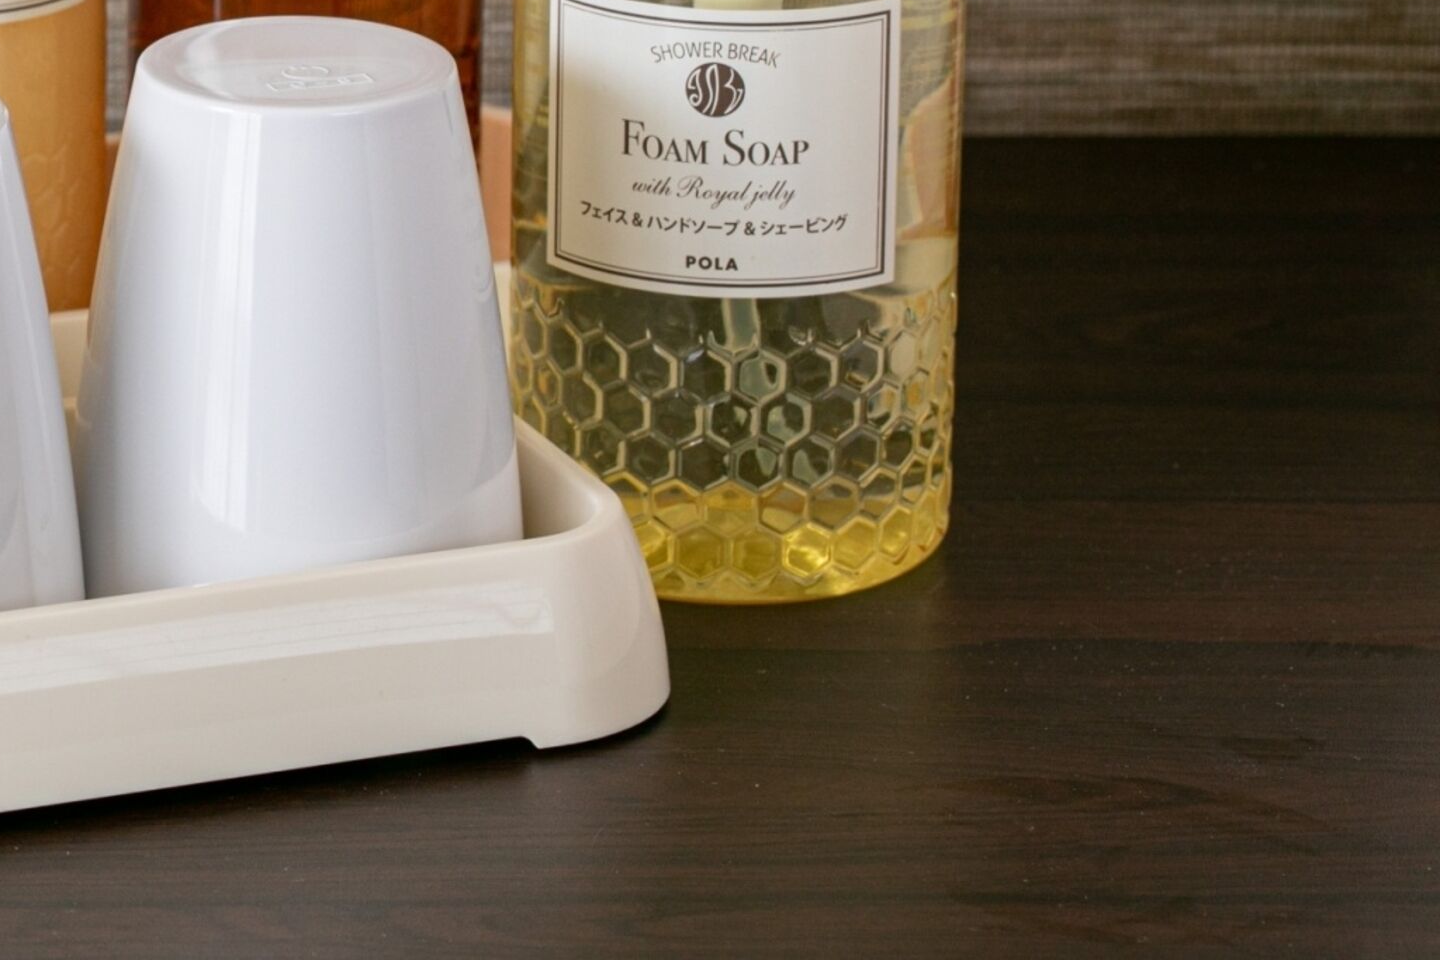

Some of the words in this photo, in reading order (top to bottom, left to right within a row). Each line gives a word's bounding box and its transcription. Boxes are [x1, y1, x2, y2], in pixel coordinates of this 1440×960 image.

[650, 41, 723, 65] SHOWER
[728, 42, 782, 69] BREAK
[621, 118, 710, 166] FOAM
[722, 129, 809, 167] SOAP
[632, 176, 672, 198] with
[676, 176, 749, 210] Royal
[745, 180, 798, 211] jelly
[685, 255, 738, 272] POLA
